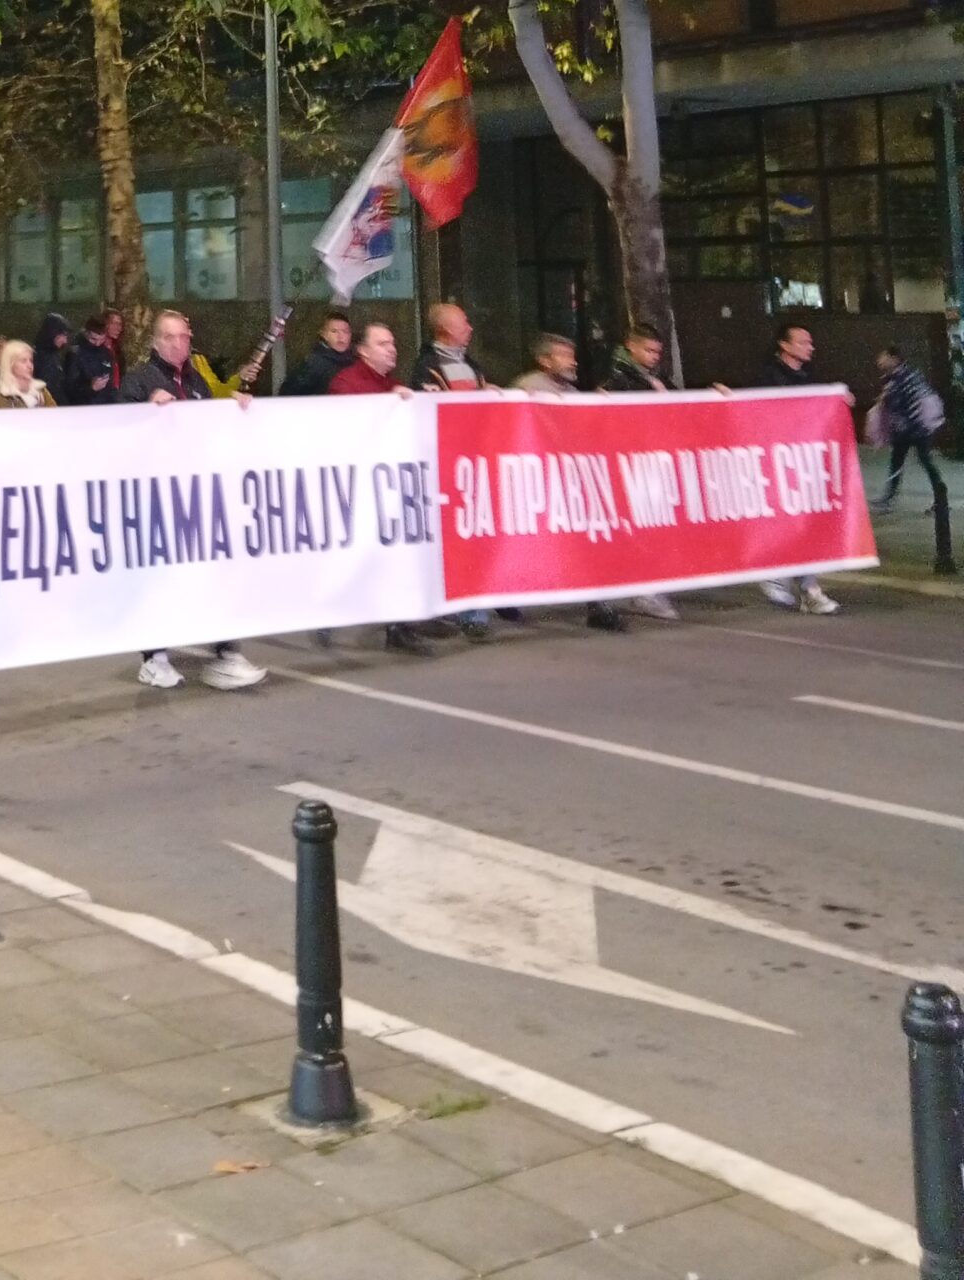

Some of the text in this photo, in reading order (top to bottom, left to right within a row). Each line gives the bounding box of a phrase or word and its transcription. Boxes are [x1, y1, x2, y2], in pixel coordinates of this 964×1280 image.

[85, 480, 113, 573] У
[119, 472, 233, 570] НАМА
[242, 463, 357, 558] ЗНАЈУ
[455, 453, 497, 540] ЗА
[616, 449, 682, 530] МИР
[676, 448, 707, 525] И
[697, 443, 776, 522] НОВЕ
